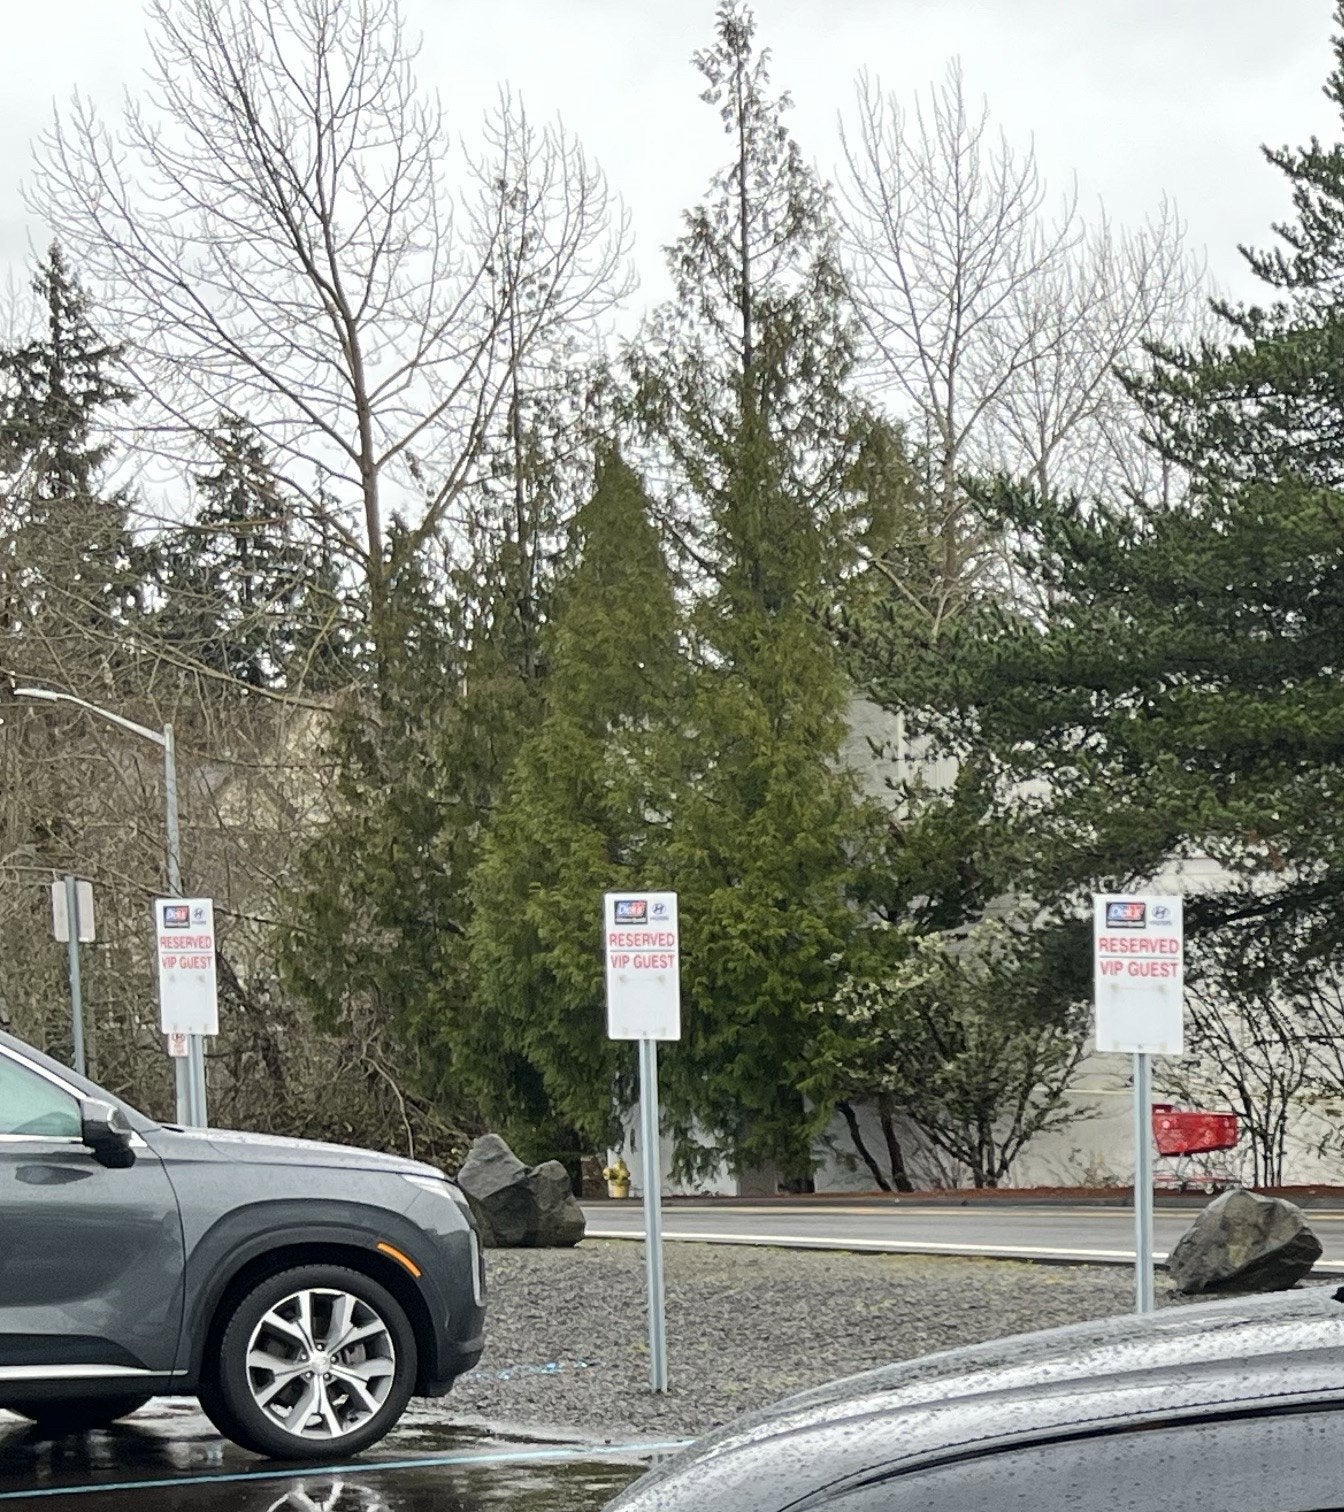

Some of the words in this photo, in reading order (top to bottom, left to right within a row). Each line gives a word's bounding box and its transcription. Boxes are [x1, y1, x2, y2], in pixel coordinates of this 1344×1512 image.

[160, 935, 212, 950] RESERVED
[609, 932, 675, 947] RESERVED
[1098, 937, 1180, 954] RESERVED
[161, 956, 177, 969] VIP
[179, 956, 212, 969] GUEST
[610, 954, 630, 969] VIP
[633, 954, 676, 969] GUEST
[1100, 960, 1123, 976] VIP
[1128, 961, 1178, 977] GUEST
